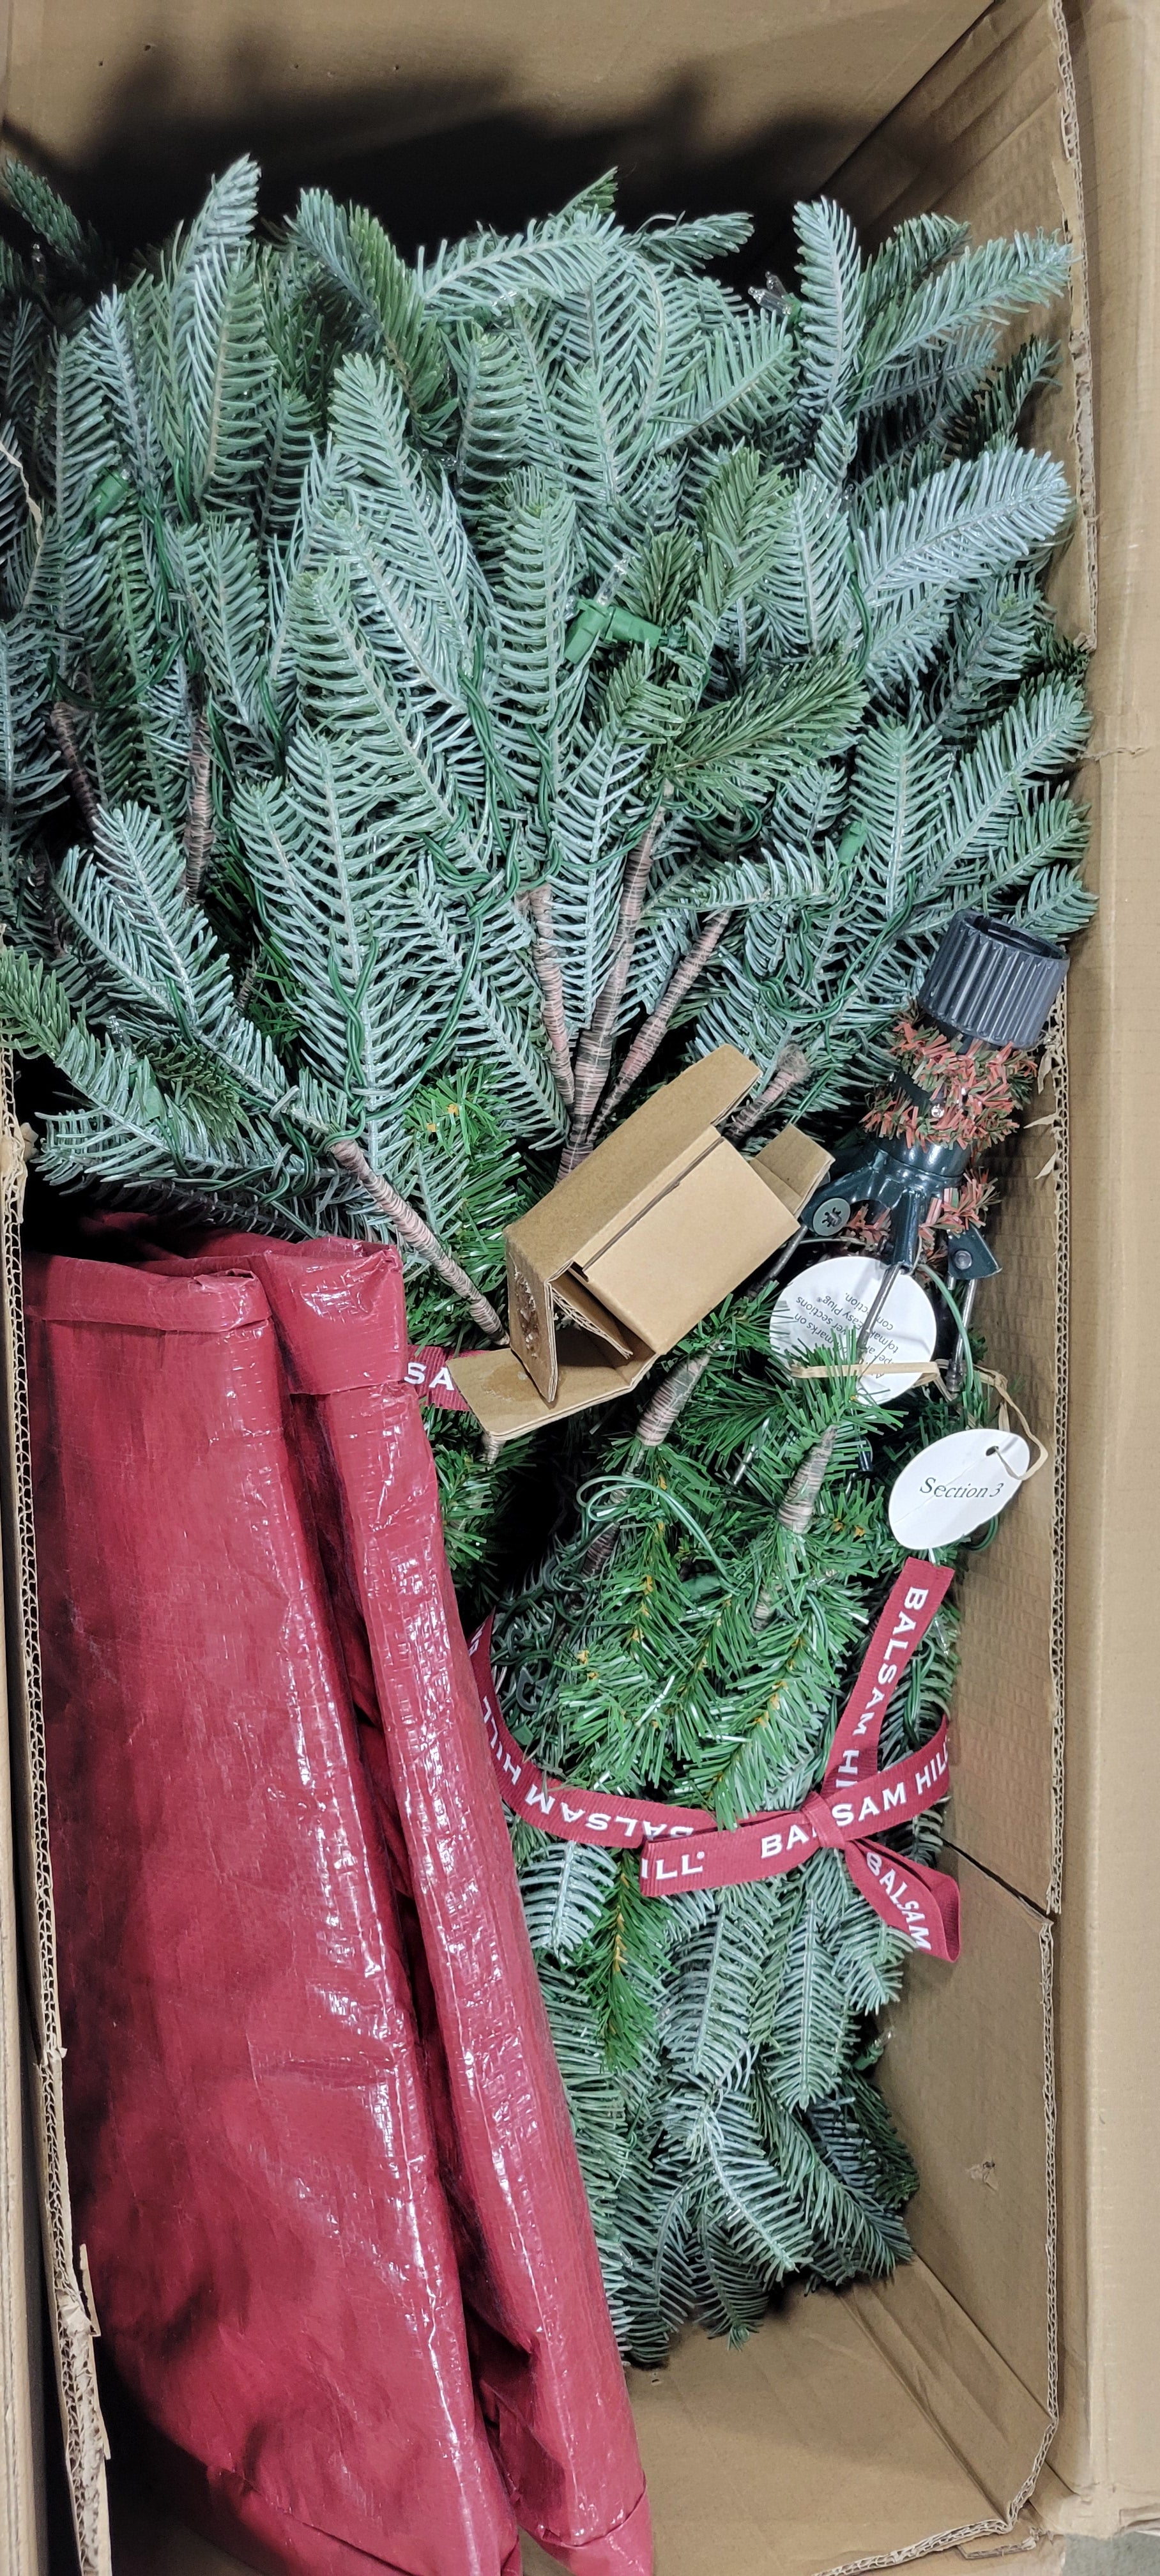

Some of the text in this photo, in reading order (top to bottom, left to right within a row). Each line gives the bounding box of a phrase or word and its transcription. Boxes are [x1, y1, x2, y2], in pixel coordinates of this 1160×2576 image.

[795, 1296, 834, 1325] sections
[816, 1295, 844, 1316] Plug®
[841, 1310, 864, 1330] Easy
[844, 1292, 894, 1330] conction.
[795, 1313, 834, 1344] marks on
[888, 1342, 899, 1354] to
[404, 1361, 455, 1391] SA
[920, 1477, 1004, 1498] Section 3
[836, 1586, 929, 1788] BALSAM HI
[641, 1850, 705, 1880] ILL®
[866, 1851, 932, 1951] BALSAM
